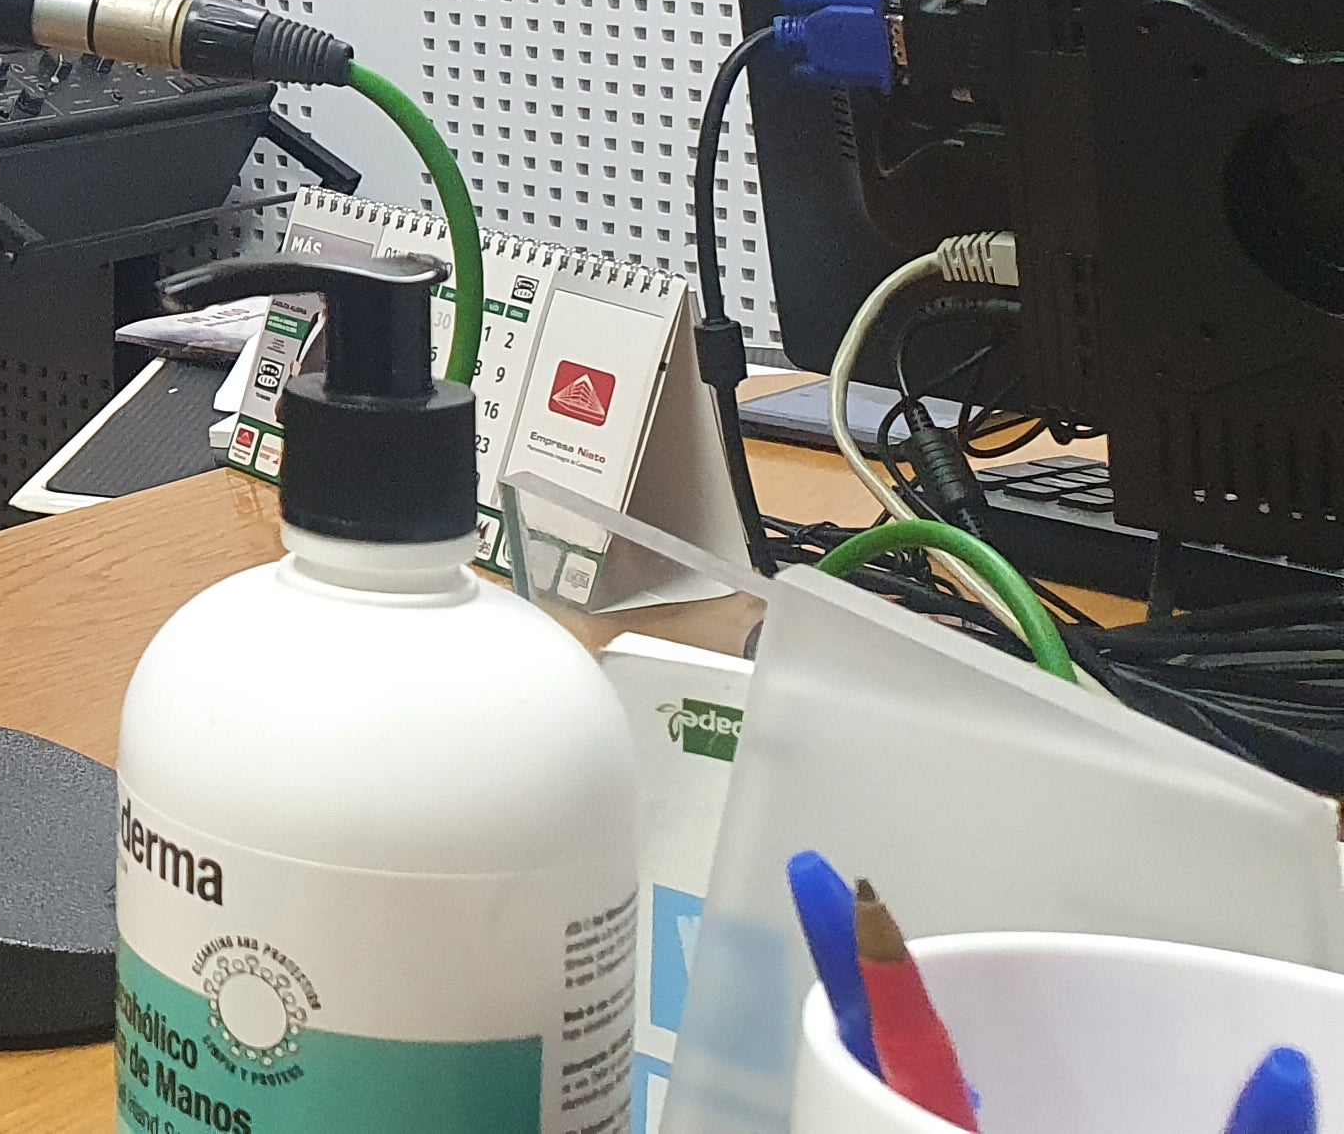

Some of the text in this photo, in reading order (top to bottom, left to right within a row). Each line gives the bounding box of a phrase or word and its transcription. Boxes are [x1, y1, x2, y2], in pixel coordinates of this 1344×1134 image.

[291, 235, 322, 255] MÁS
[433, 311, 452, 330] 30
[484, 326, 515, 349] 1 2
[495, 366, 506, 383] 9
[484, 400, 500, 419] 16
[475, 434, 490, 454] 23
[530, 431, 574, 453] Empresa
[120, 797, 223, 906] derma
[155, 1060, 252, 1134] Manos
